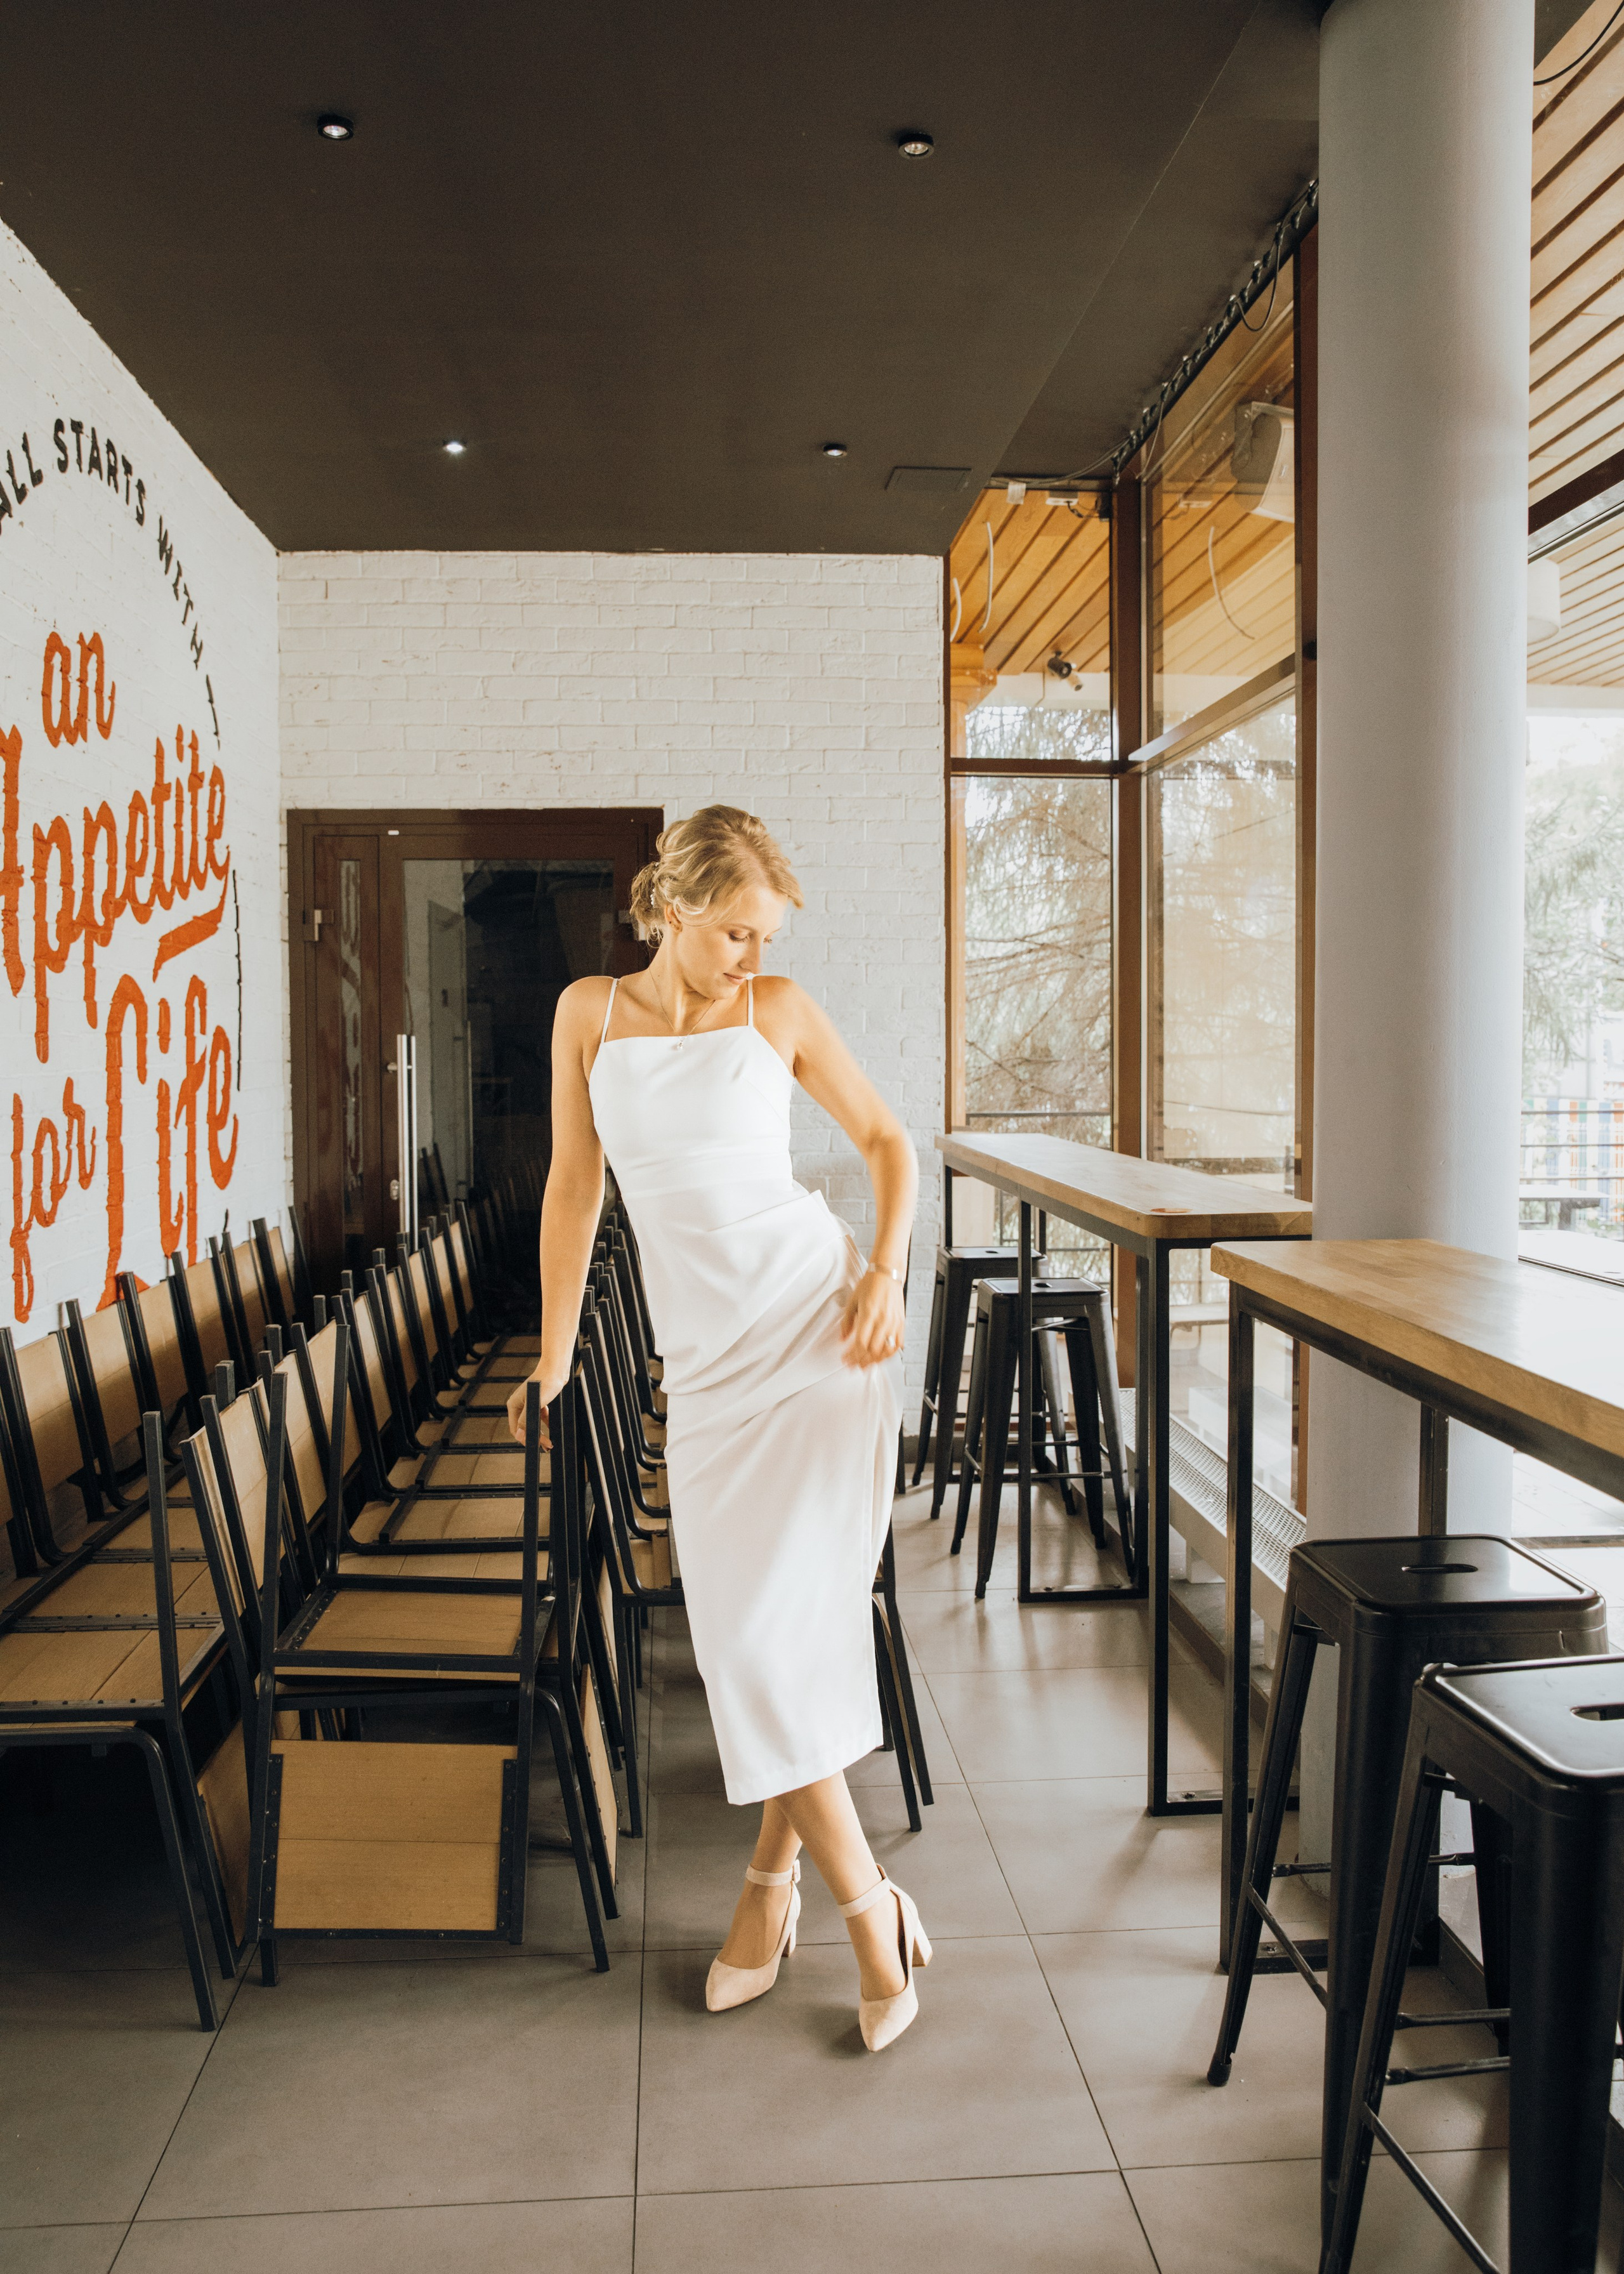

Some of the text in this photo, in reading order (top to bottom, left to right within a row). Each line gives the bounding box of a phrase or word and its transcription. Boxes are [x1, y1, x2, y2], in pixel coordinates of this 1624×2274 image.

[54, 418, 145, 527] STARTS
[157, 515, 203, 671] WITH
[41, 631, 115, 749] an
[10, 1077, 96, 1323] for
[96, 974, 239, 1311] Life
